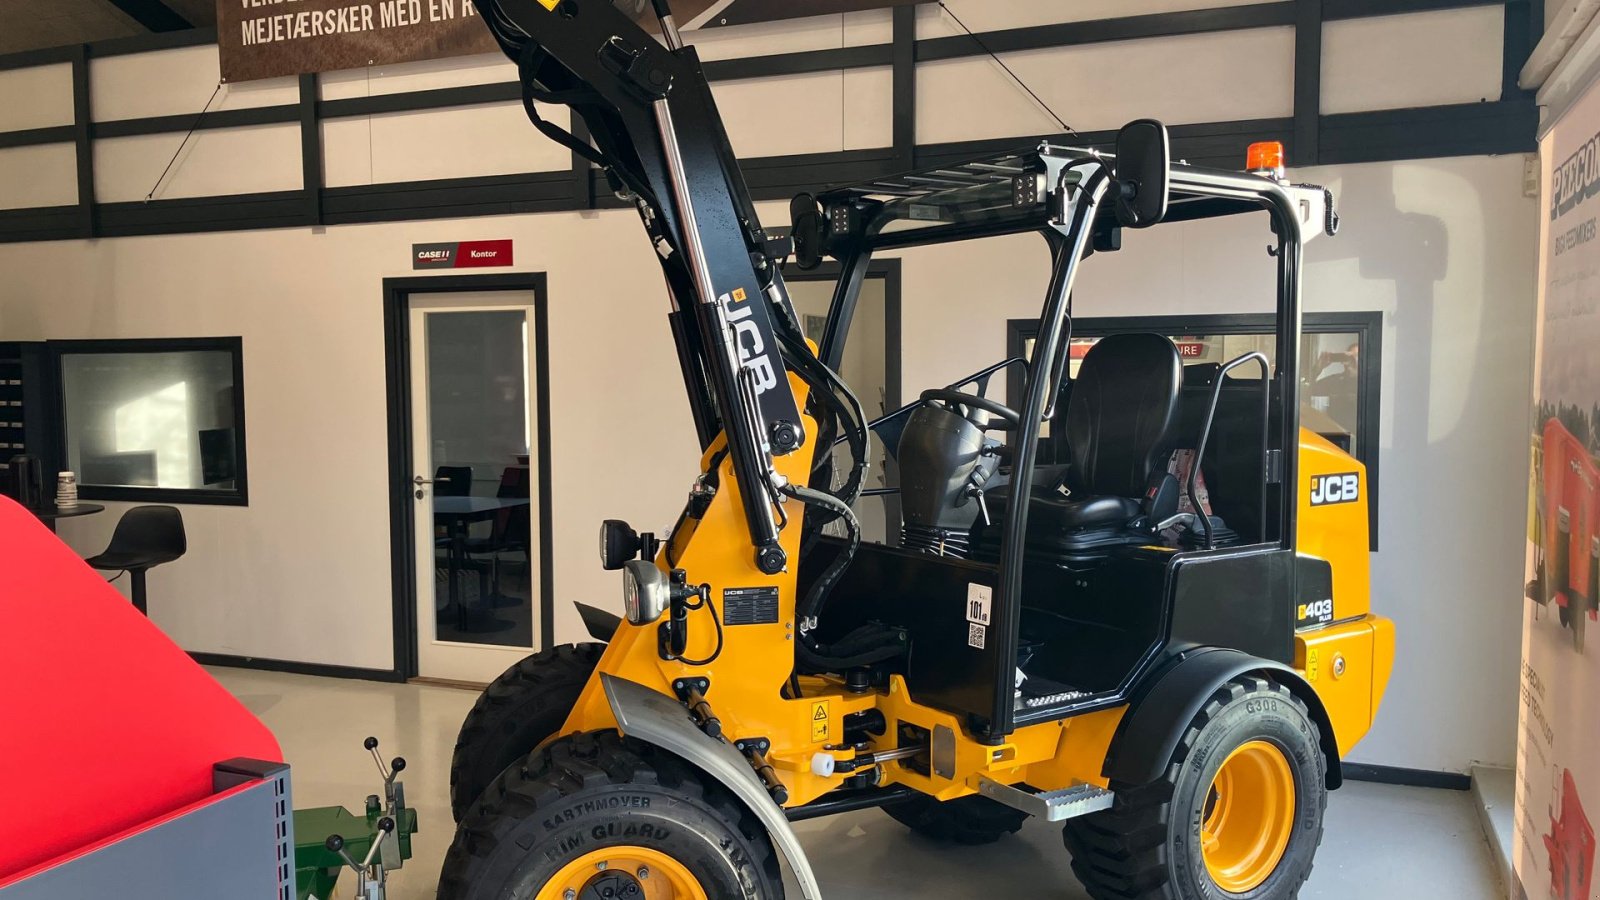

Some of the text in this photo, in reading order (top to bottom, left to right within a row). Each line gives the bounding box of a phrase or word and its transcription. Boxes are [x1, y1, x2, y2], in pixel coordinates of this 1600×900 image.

[242, 4, 374, 46] MEJETÆRSKER
[380, 0, 421, 28] MED
[429, 0, 454, 22] EN
[471, 250, 497, 258] Kontor
[718, 293, 777, 395] JCB
[1311, 474, 1358, 503] JCB
[970, 600, 982, 620] 101
[1305, 599, 1332, 618] 403
[1246, 701, 1278, 714] G308
[543, 796, 651, 832] EARTHMOVER
[591, 822, 672, 841] GUARD
